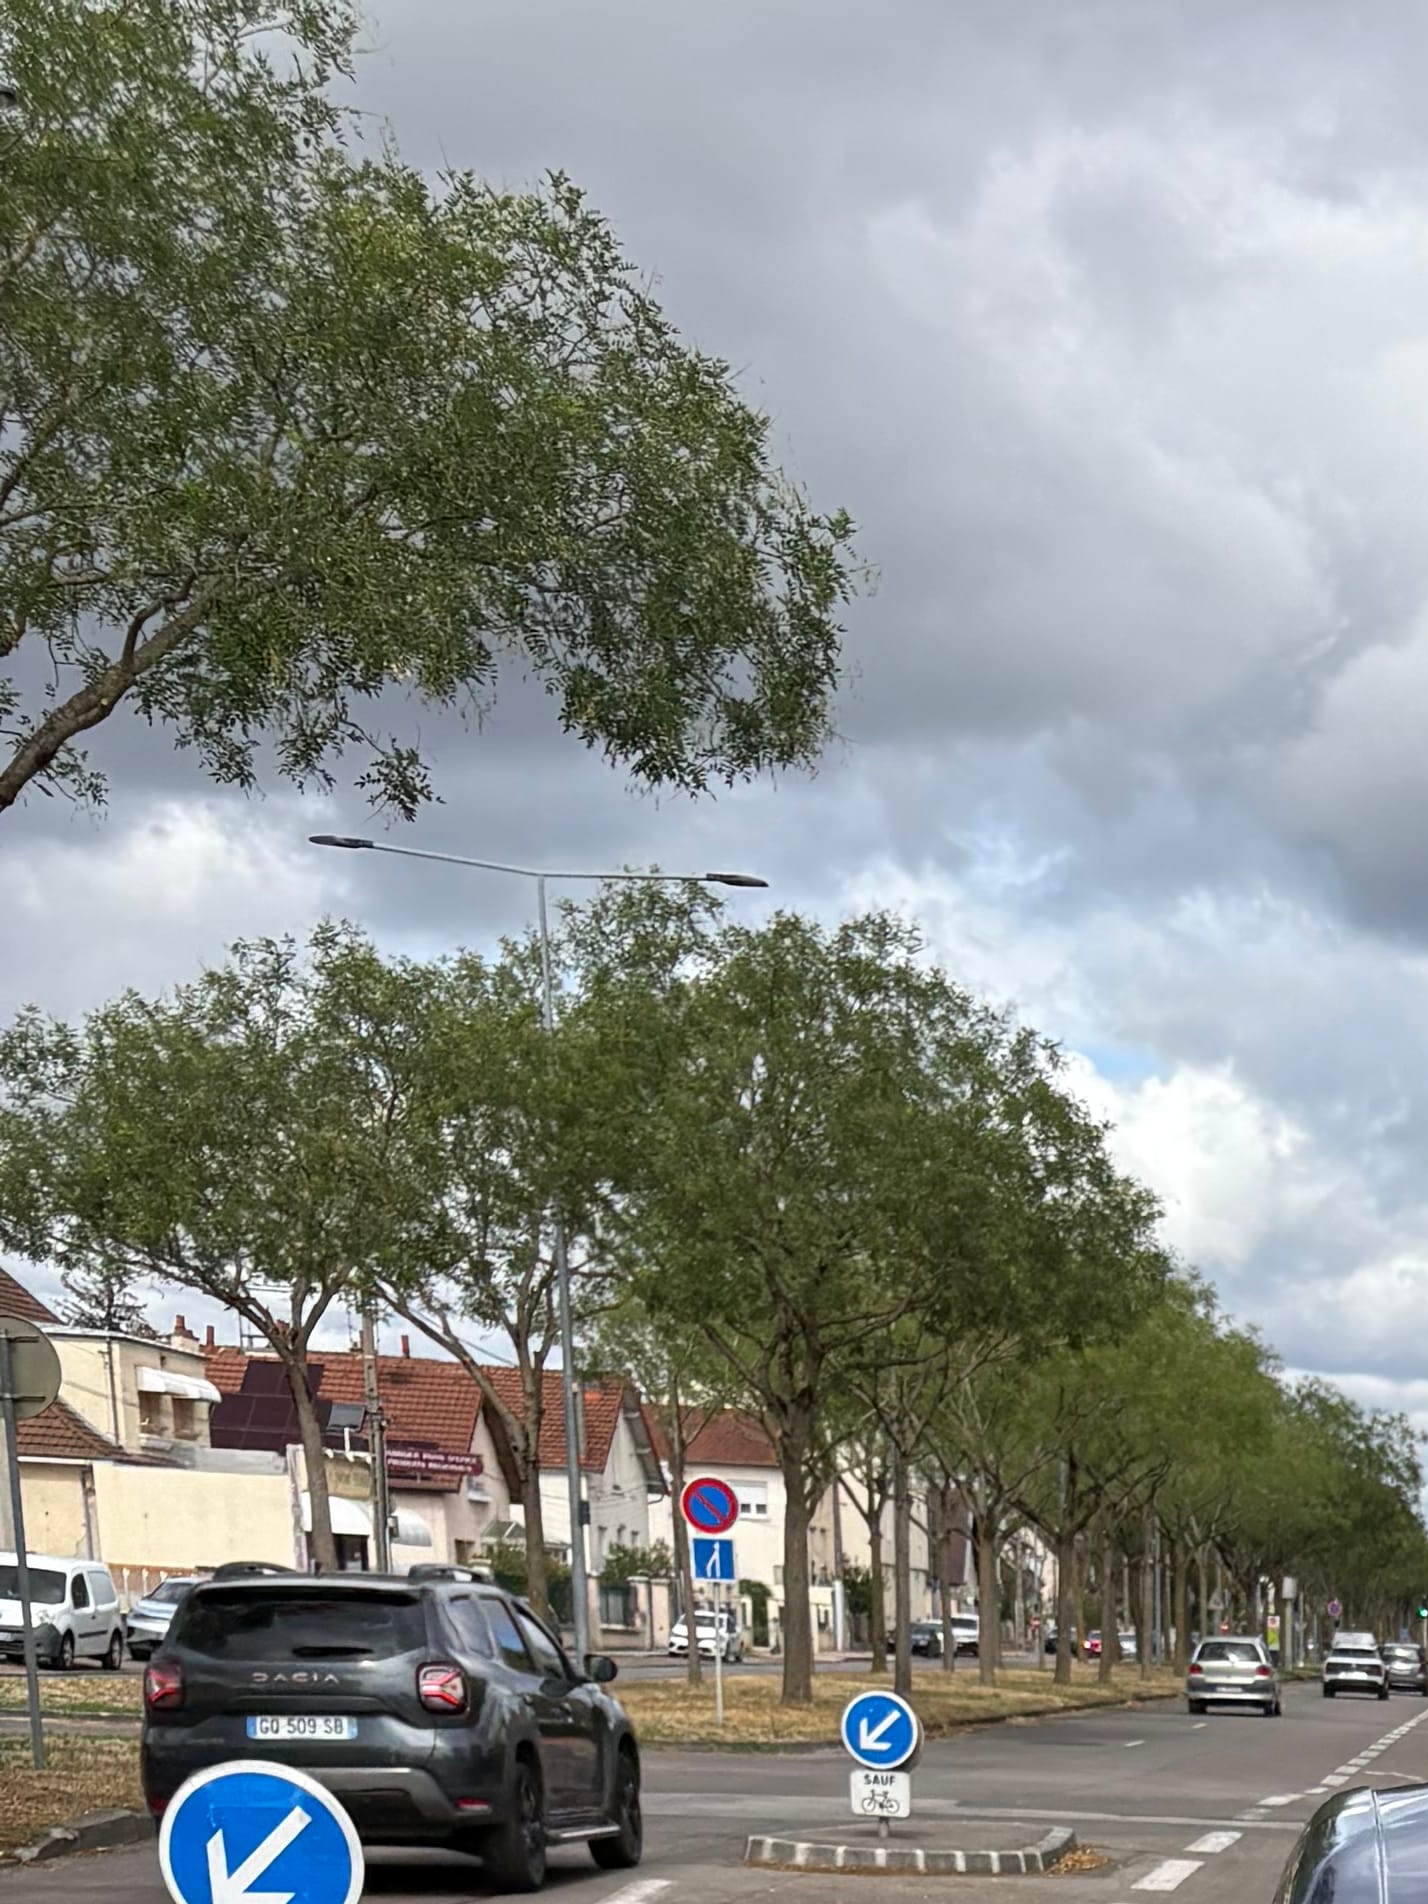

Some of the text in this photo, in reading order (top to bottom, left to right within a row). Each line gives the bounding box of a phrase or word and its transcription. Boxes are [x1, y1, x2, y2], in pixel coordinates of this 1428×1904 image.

[252, 1672, 340, 1683] DACIA
[287, 1717, 316, 1734] 509
[863, 1774, 896, 1786] SAUF
